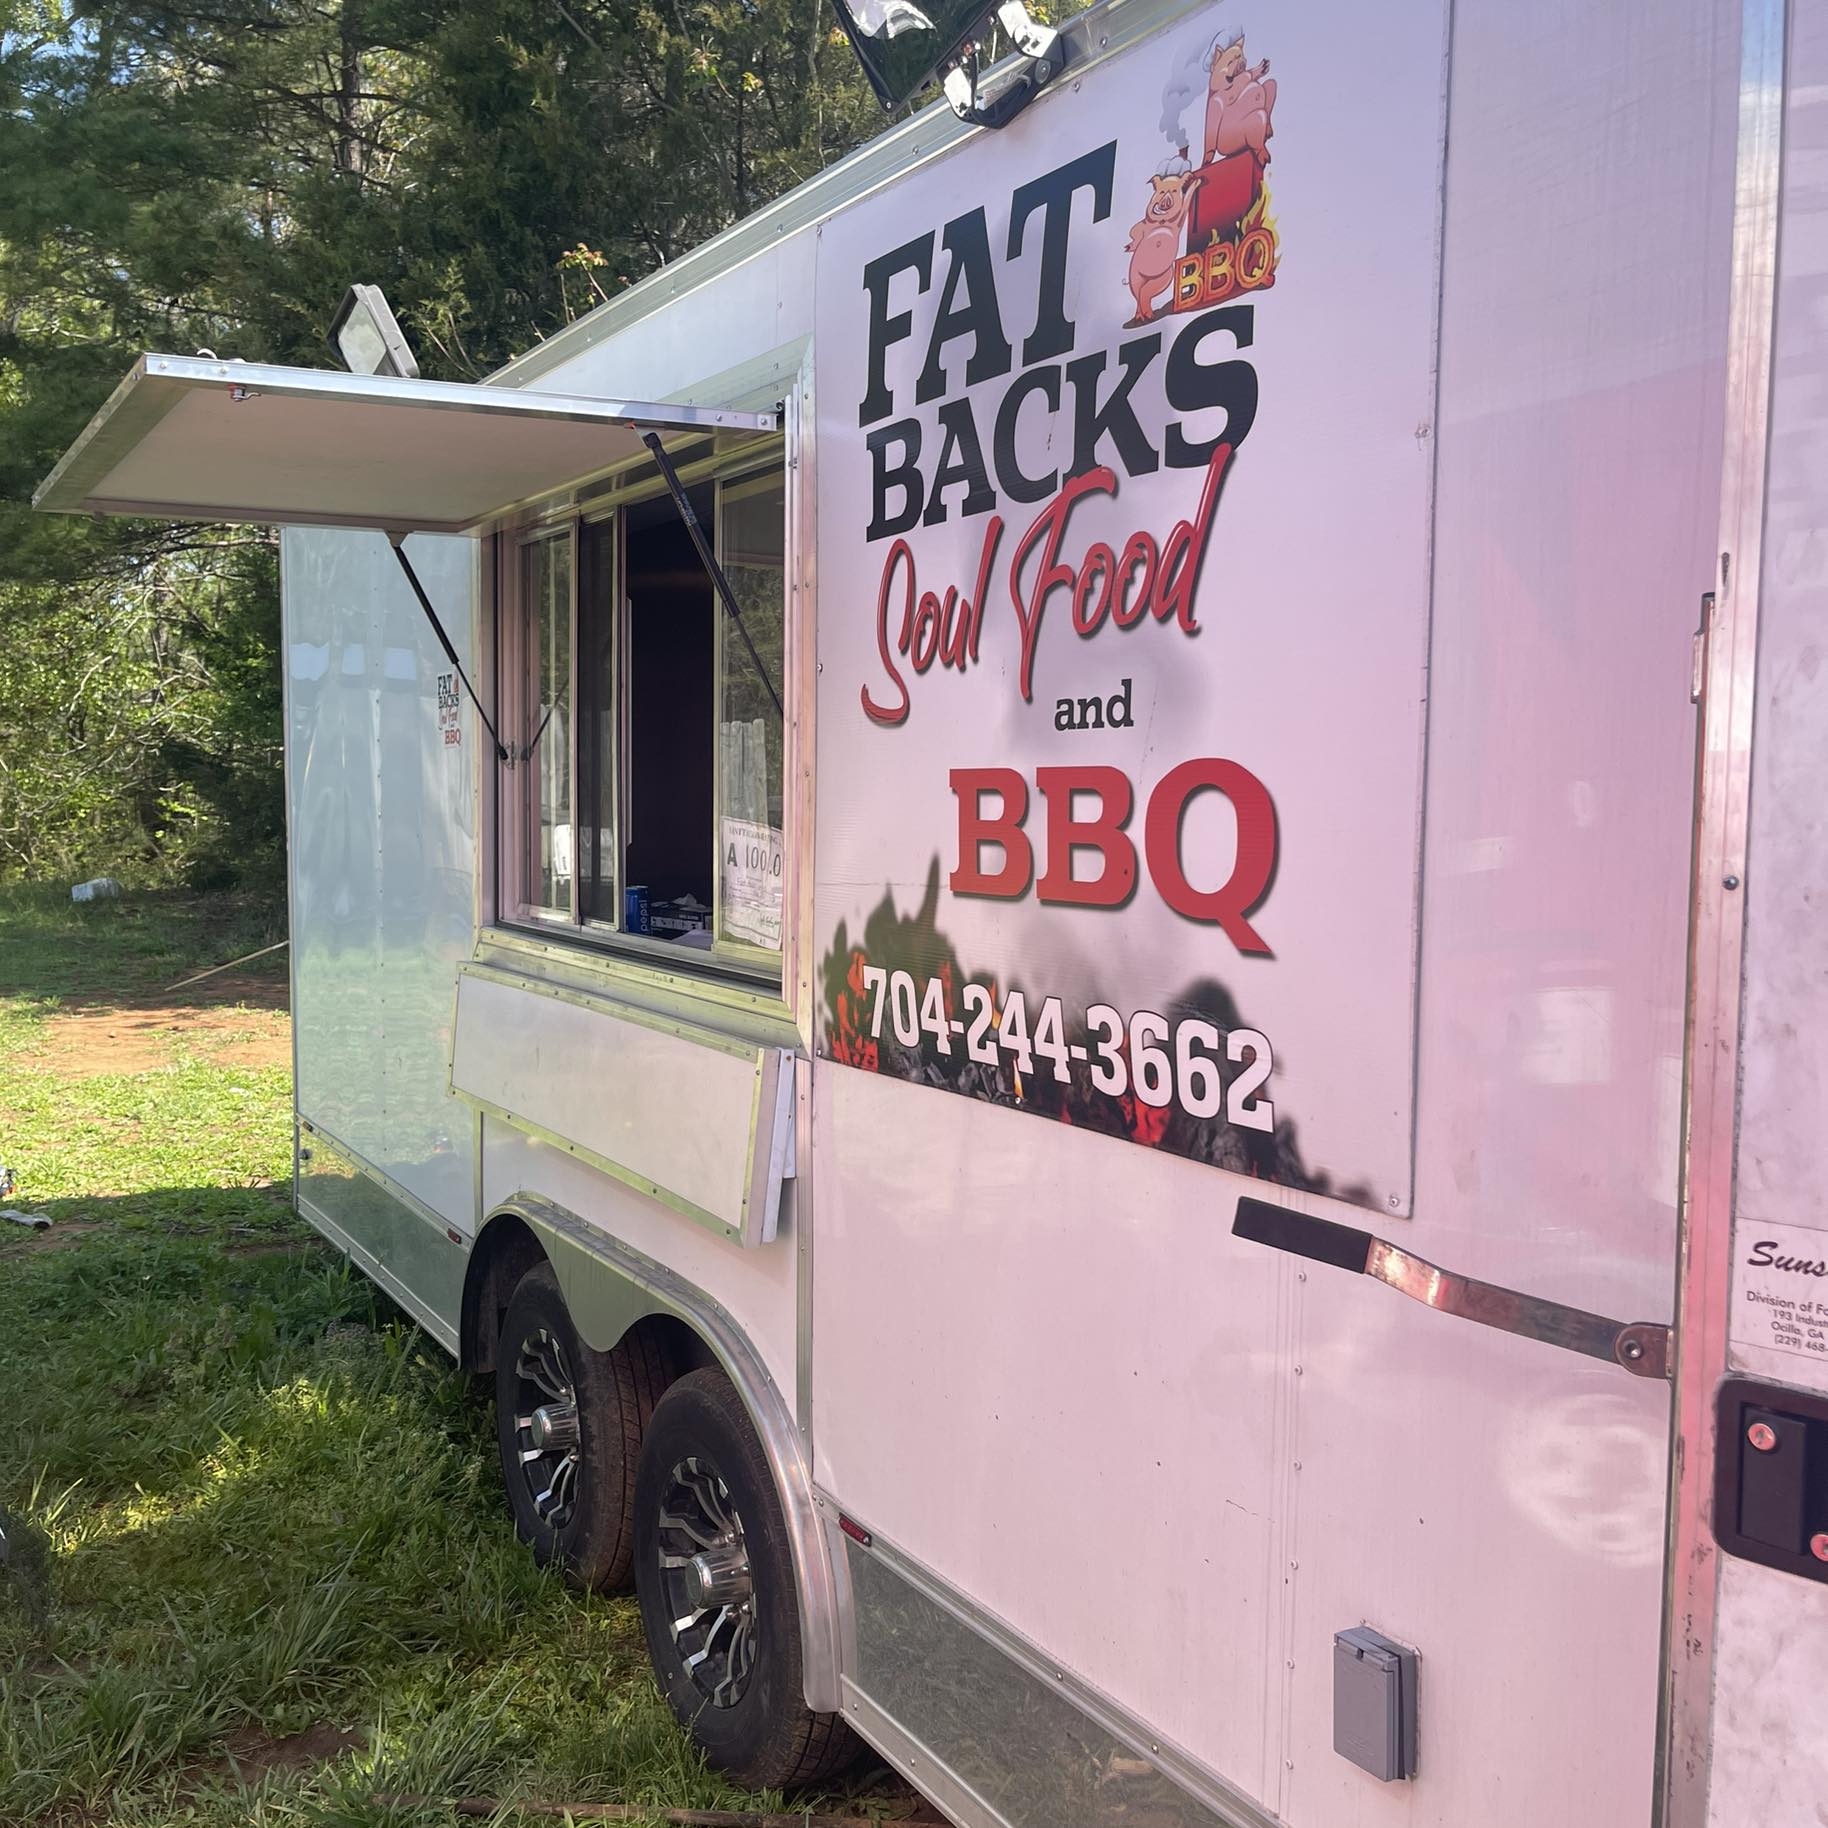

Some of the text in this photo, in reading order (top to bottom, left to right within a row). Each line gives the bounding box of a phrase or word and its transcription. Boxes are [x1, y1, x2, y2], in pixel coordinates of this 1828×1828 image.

[859, 139, 1118, 428] FAT
[1174, 227, 1276, 312] BBQ
[866, 305, 1259, 542] BACKS
[861, 443, 1237, 725] Soul Food
[1054, 678, 1135, 731] and
[726, 842, 738, 868] A
[949, 757, 1279, 960] BBQ
[639, 900, 648, 931] pepsi
[862, 964, 1275, 1134] 704-244-3662
[1746, 1290, 1796, 1310] Division
[1799, 1301, 1814, 1313] of
[1770, 1320, 1825, 1341] Ocilla, GA
[1772, 1308, 1793, 1322] 193
